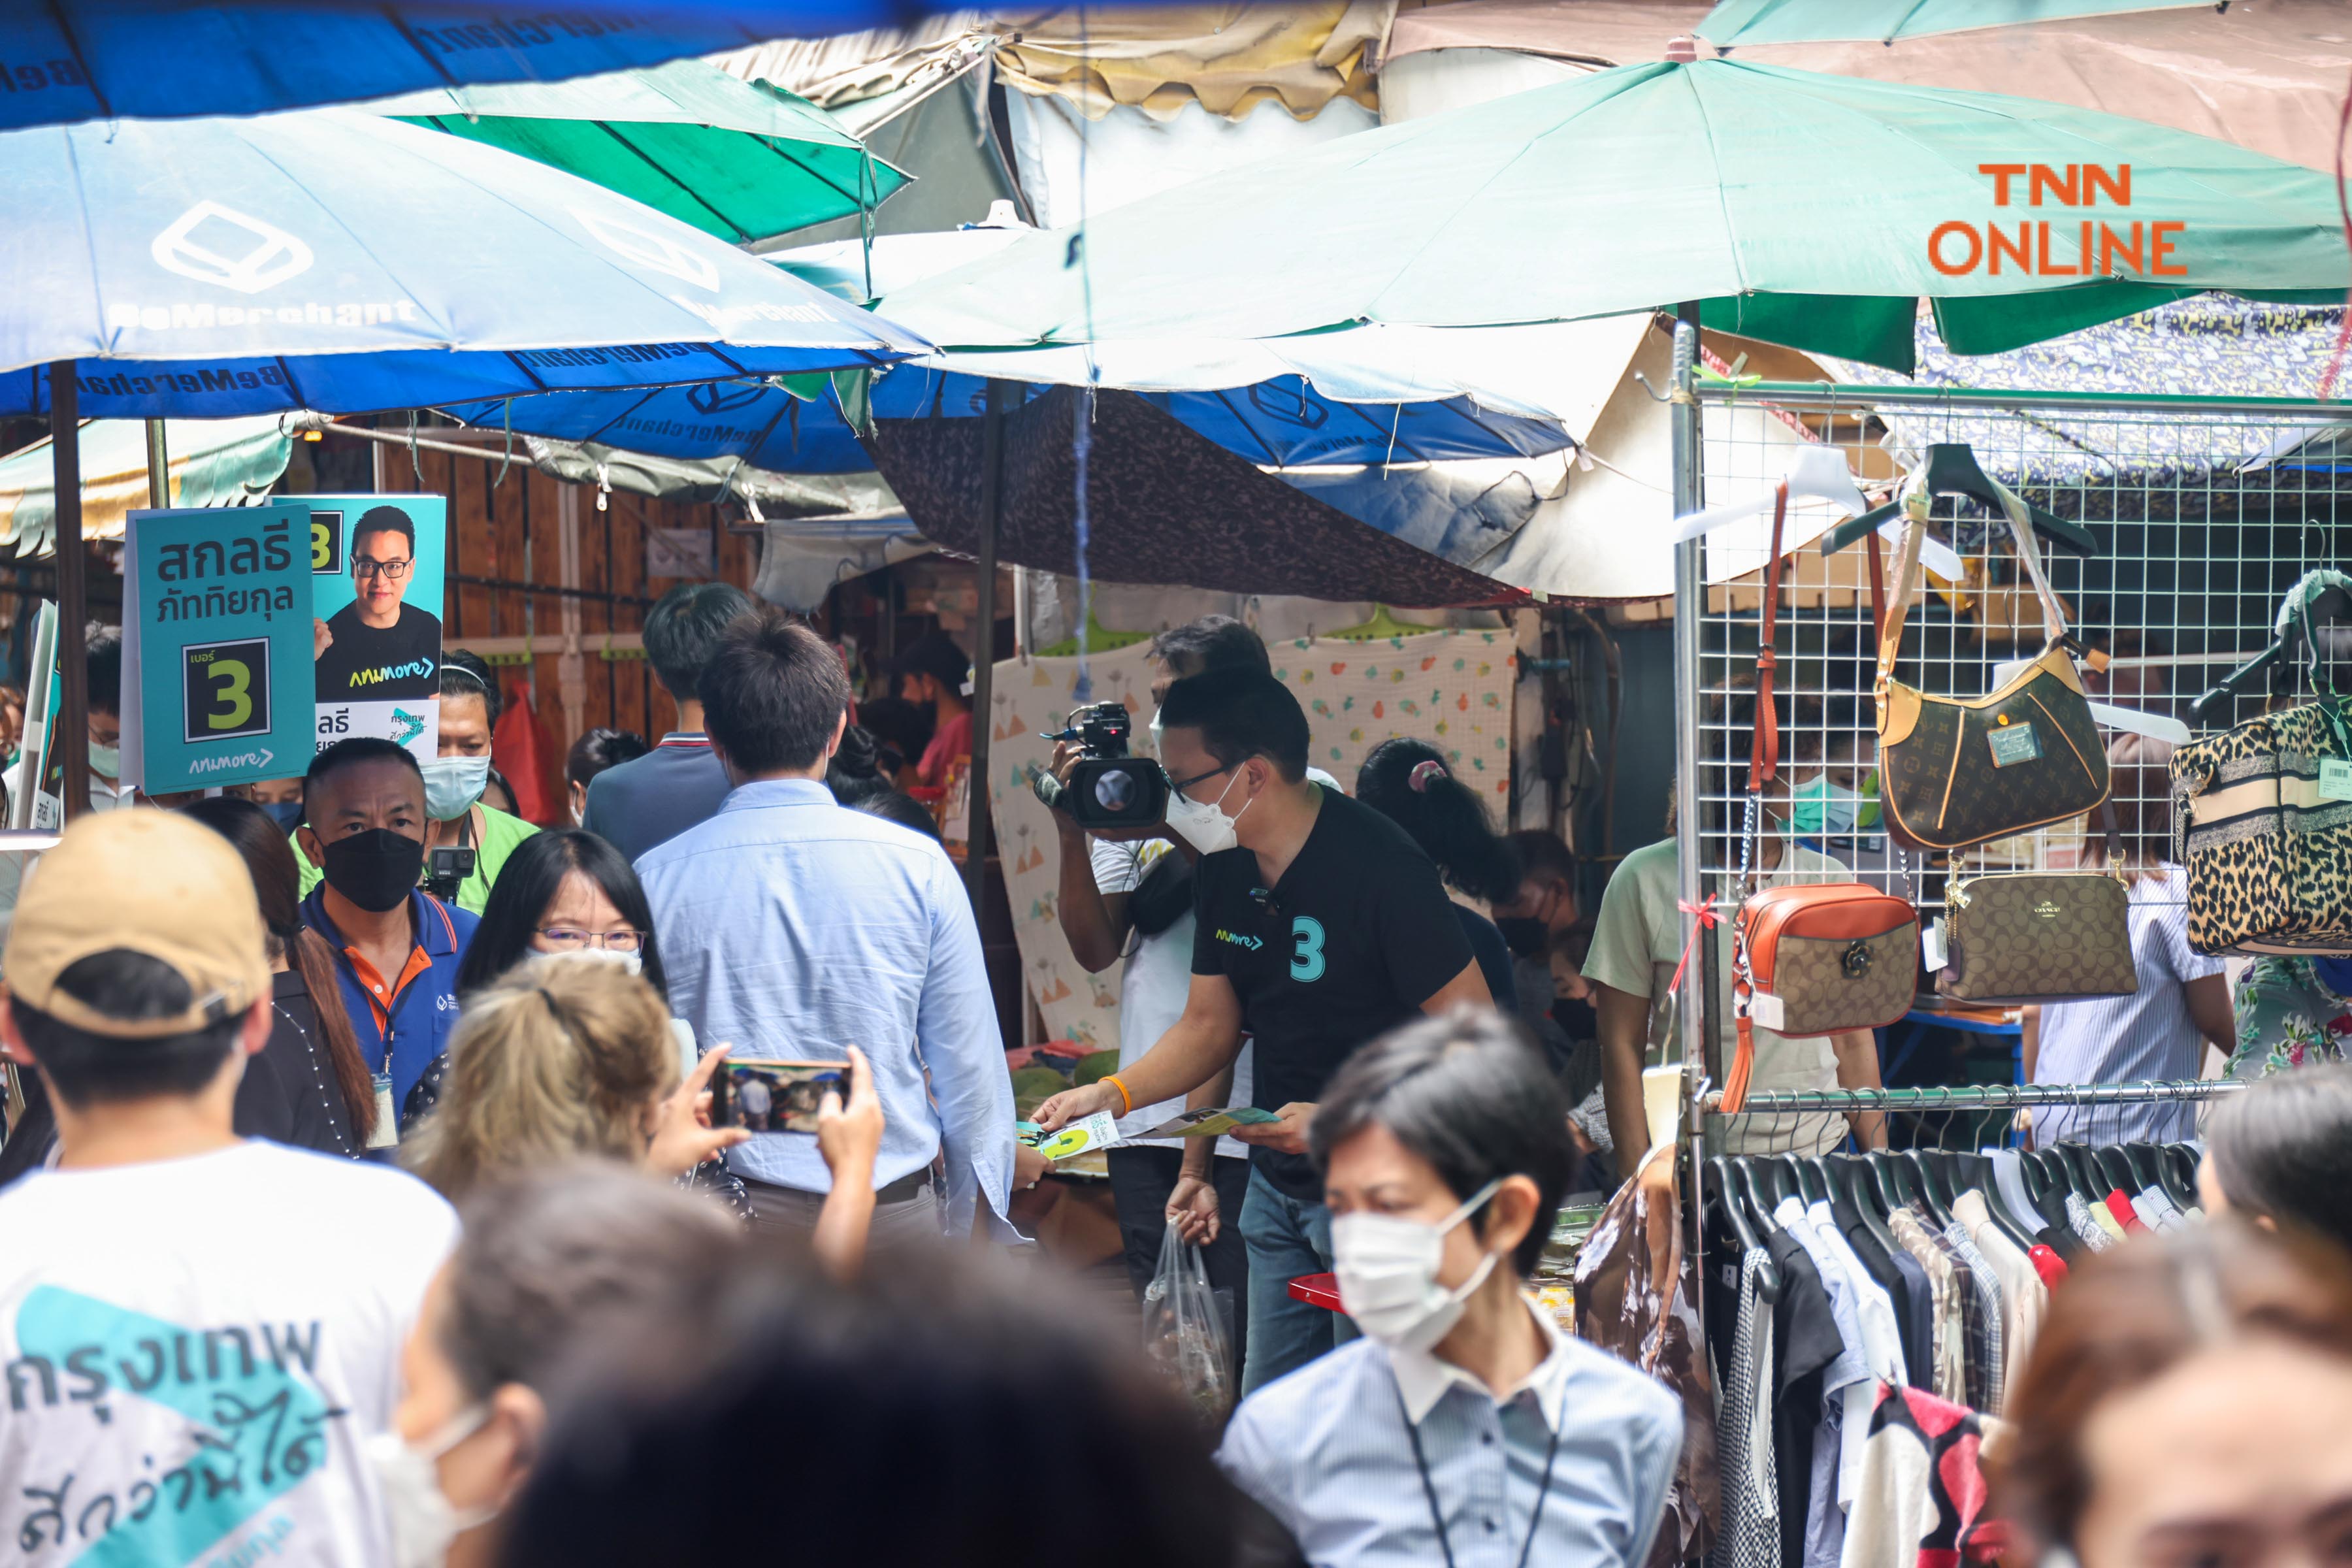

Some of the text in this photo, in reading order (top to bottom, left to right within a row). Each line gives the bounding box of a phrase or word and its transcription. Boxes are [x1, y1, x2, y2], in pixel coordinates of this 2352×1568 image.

[157, 518, 291, 581] สกลธี
[157, 585, 293, 622] ภัททิยกุล
[190, 650, 215, 663] เบอร์
[208, 659, 252, 729] 3
[318, 708, 349, 734] ลธี
[391, 714, 425, 726] กรุงเทพ
[1290, 916, 1325, 982] 3
[6, 1321, 320, 1425] กรุงเทพ
